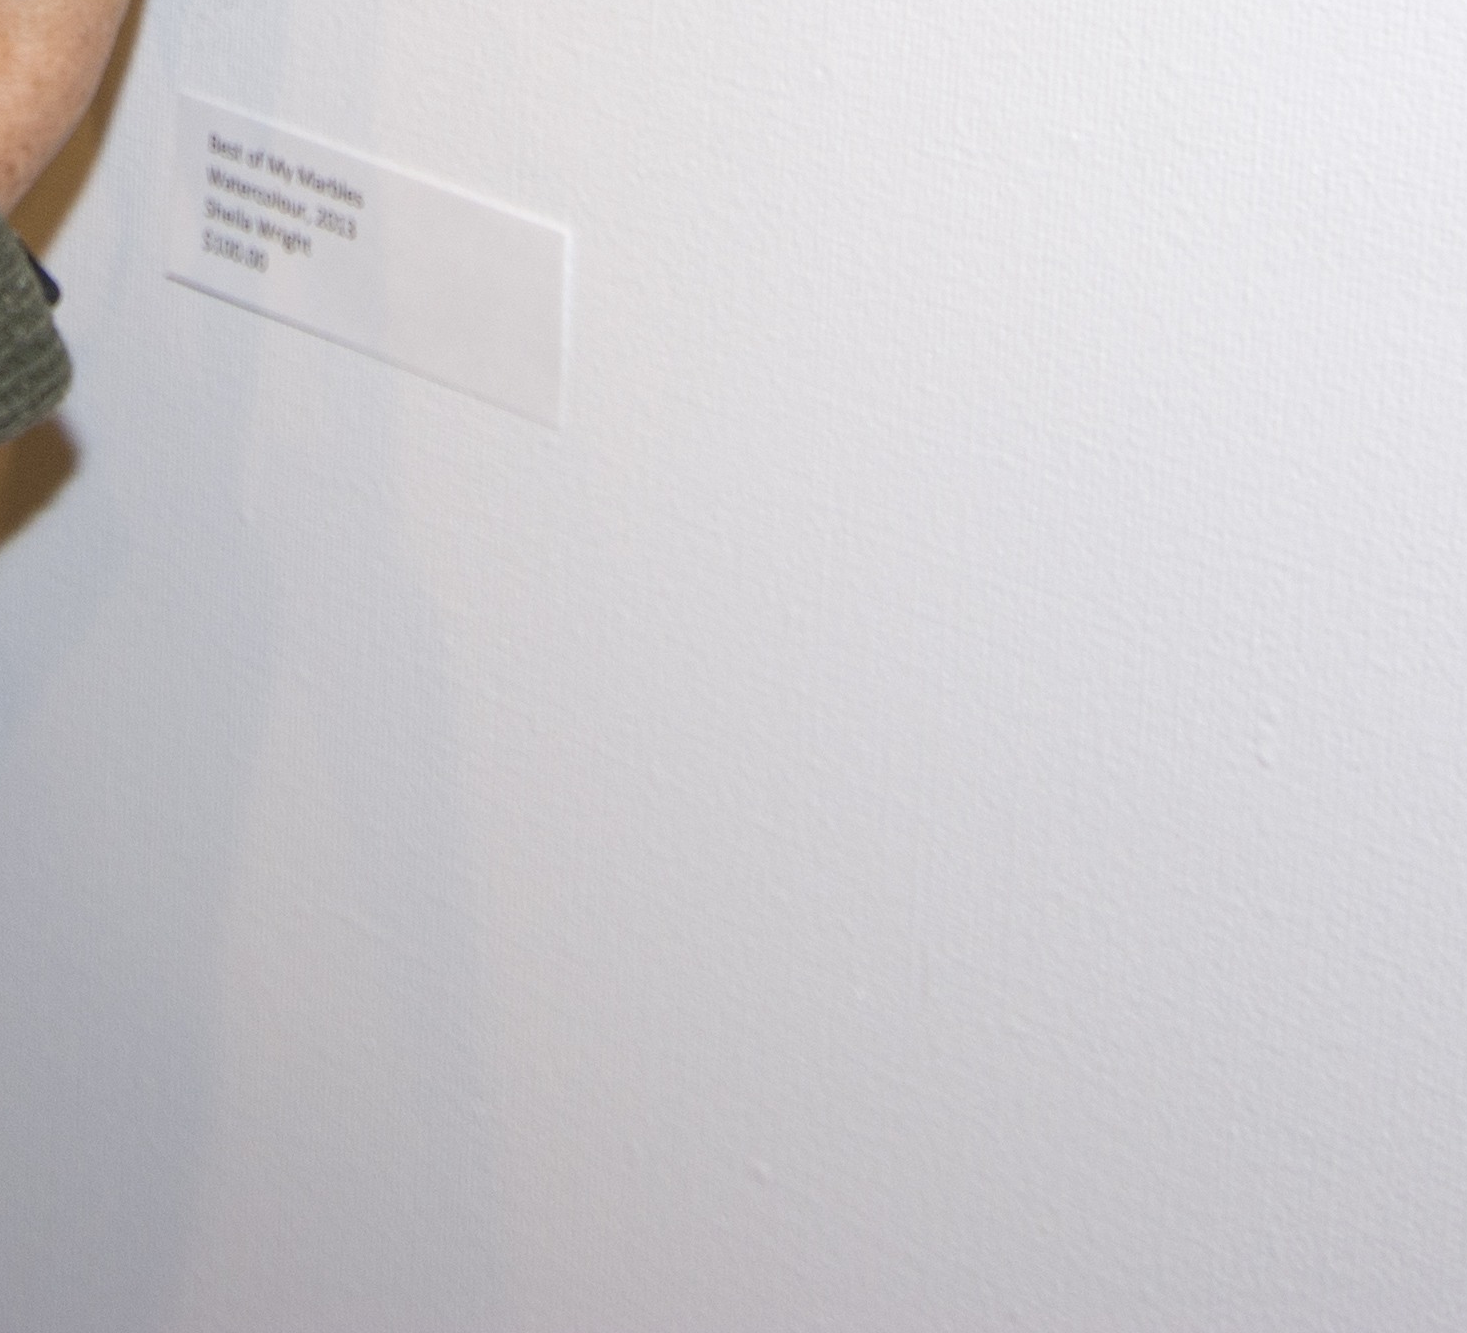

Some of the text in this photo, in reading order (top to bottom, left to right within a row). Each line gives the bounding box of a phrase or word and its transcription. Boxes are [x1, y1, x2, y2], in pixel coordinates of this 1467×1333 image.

[206, 165, 312, 225] Watercolour,
[246, 148, 265, 169] of
[266, 154, 293, 185] My
[296, 165, 365, 209] Marbles
[255, 214, 313, 257] Wright
